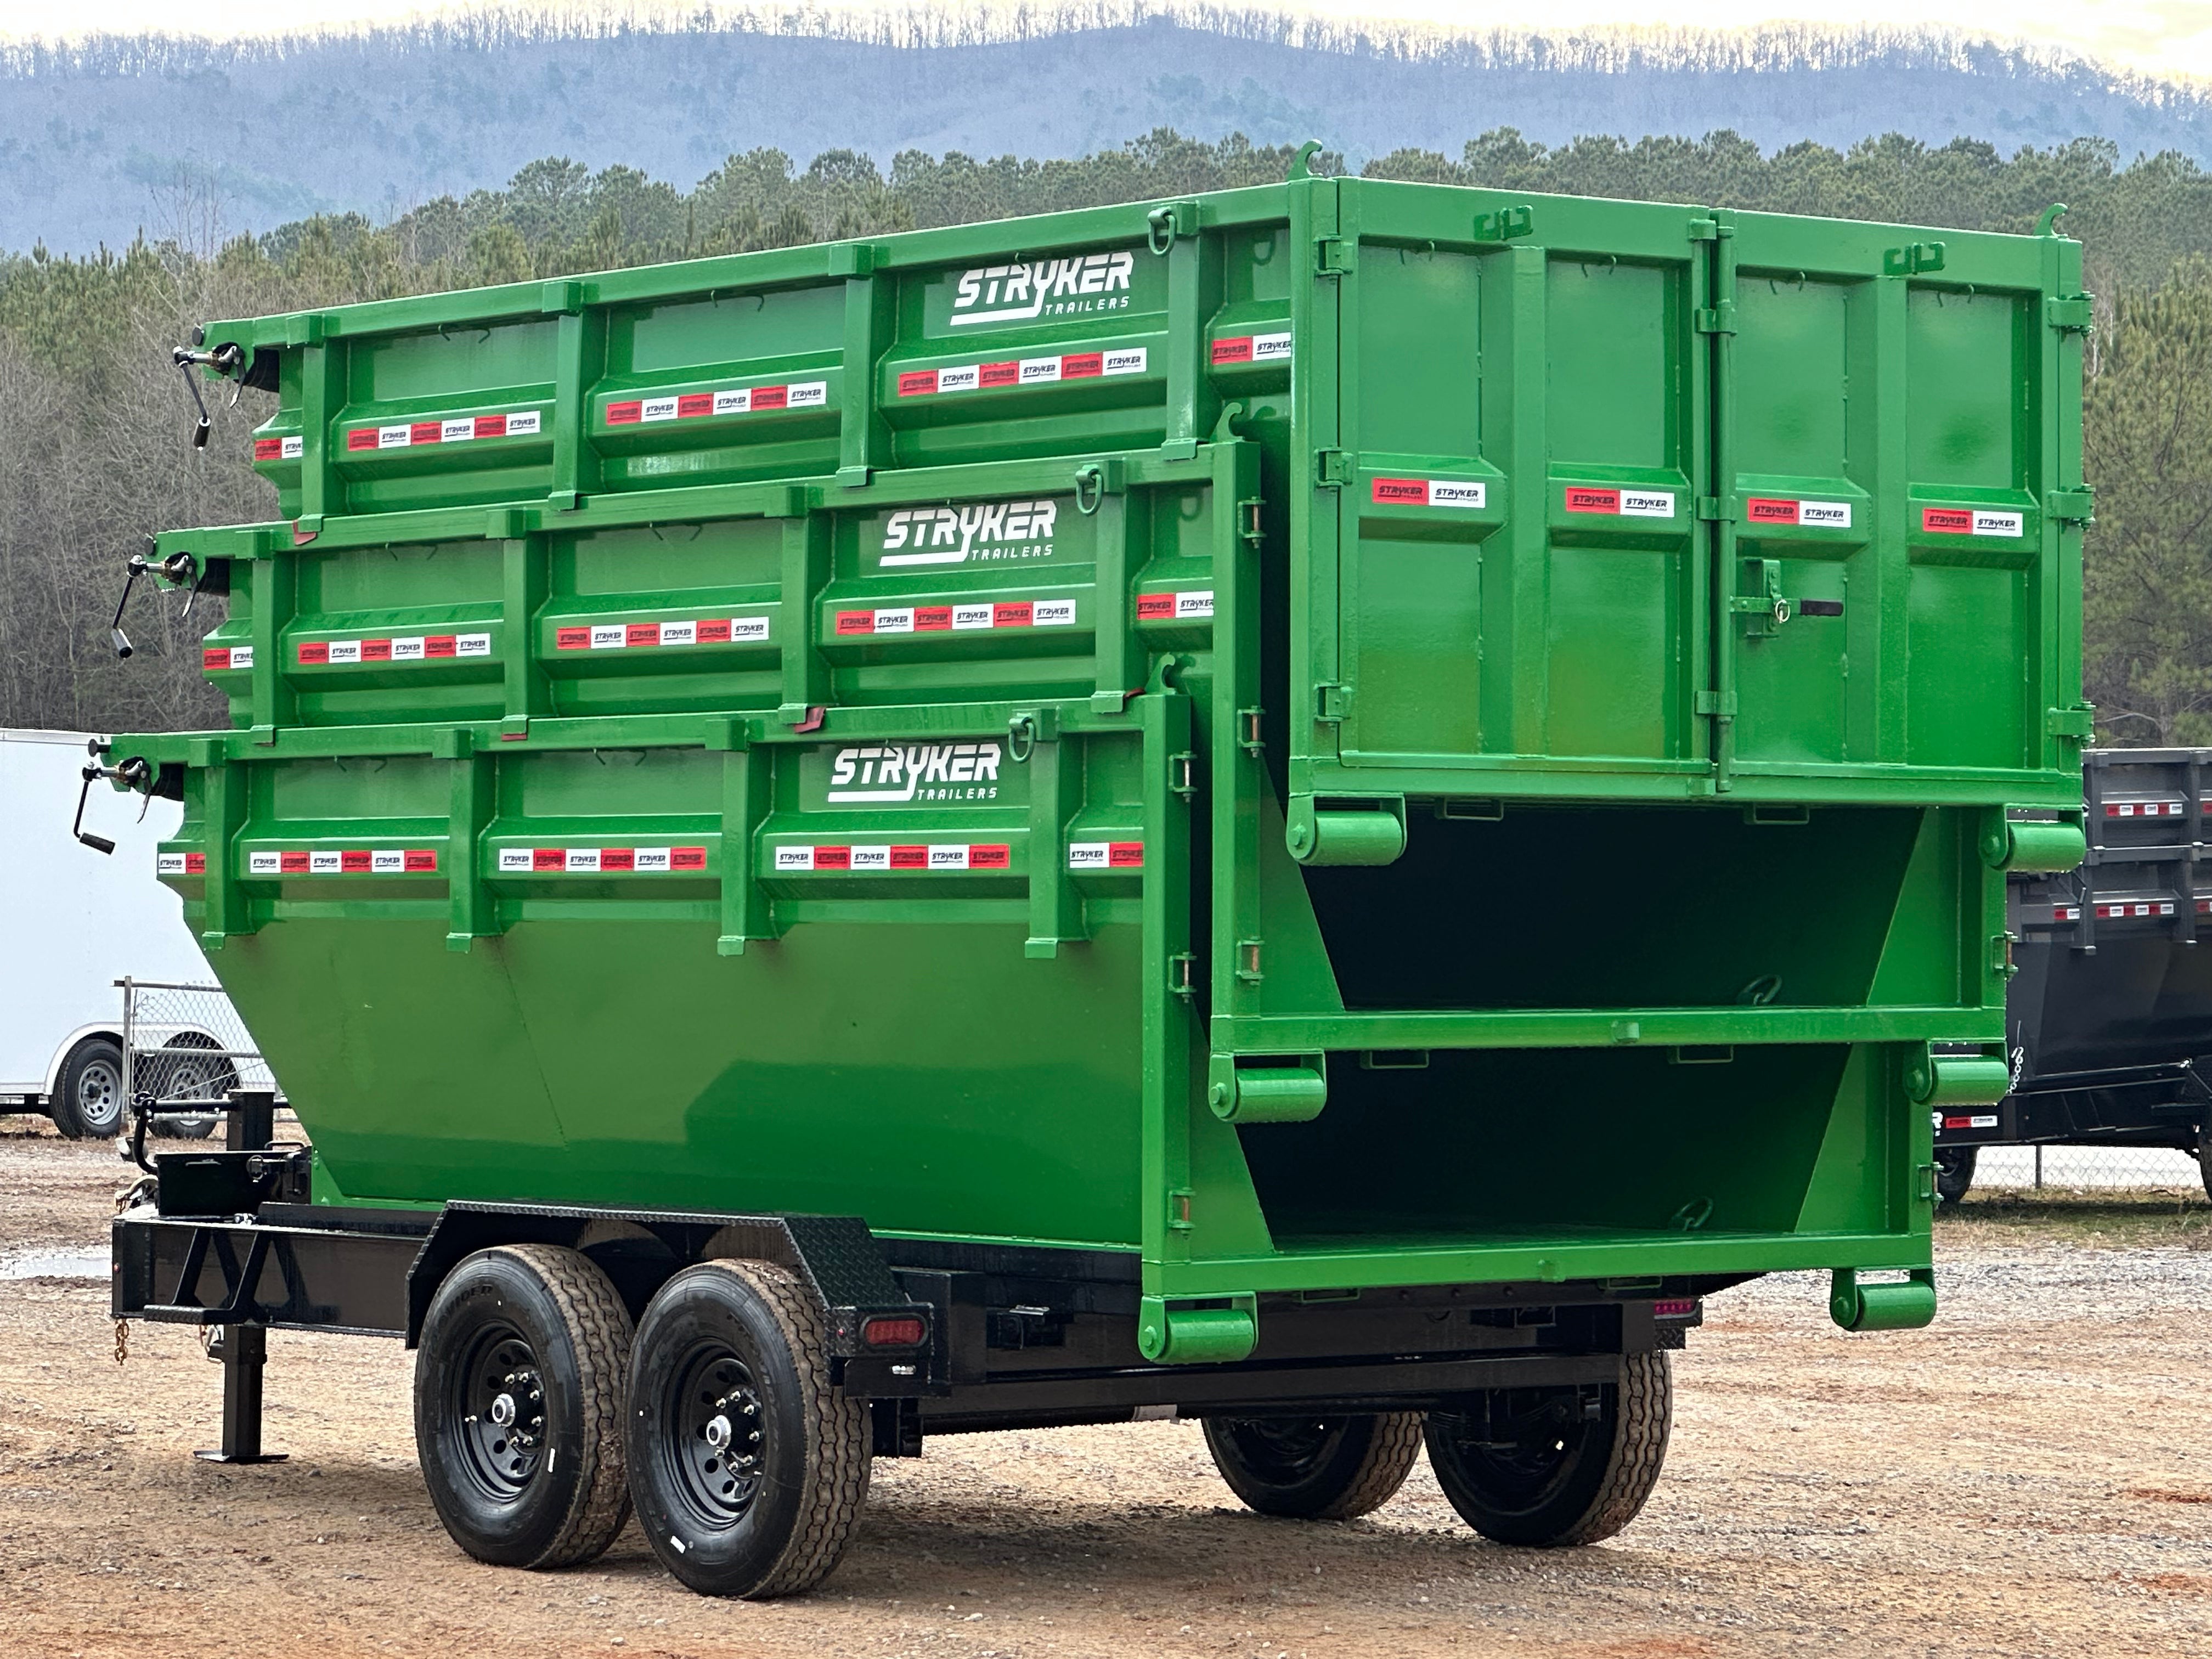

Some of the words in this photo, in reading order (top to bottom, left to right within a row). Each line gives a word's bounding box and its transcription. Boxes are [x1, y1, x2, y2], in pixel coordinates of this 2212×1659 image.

[950, 252, 1134, 326] STRYKER
[1045, 296, 1130, 316] TRAILERS
[942, 373, 974, 386] STRYKER
[1023, 364, 1056, 378] STRYKER
[1107, 356, 1141, 370] STRYKER
[1378, 486, 1423, 497] STRYKER
[1435, 488, 1479, 500] STRYKER
[1573, 495, 1615, 506] STRYKER
[1625, 498, 1667, 509] STRYKER
[1753, 506, 1794, 517] STRYKER
[1804, 509, 1844, 520] STRYKER
[1928, 516, 1968, 527] STRYKER
[1977, 519, 2016, 529] STRYKER
[879, 500, 1057, 566] STRYKER
[971, 544, 1053, 560] TRAILERS
[877, 616, 908, 627] STRYKER
[956, 612, 988, 623] STRYKER
[1036, 608, 1069, 619] STRYKER
[828, 743, 1002, 802] STRYKER
[917, 787, 998, 800] TRAILERS
[932, 853, 963, 863] STRYKER
[1070, 851, 1103, 862] STRYKER
